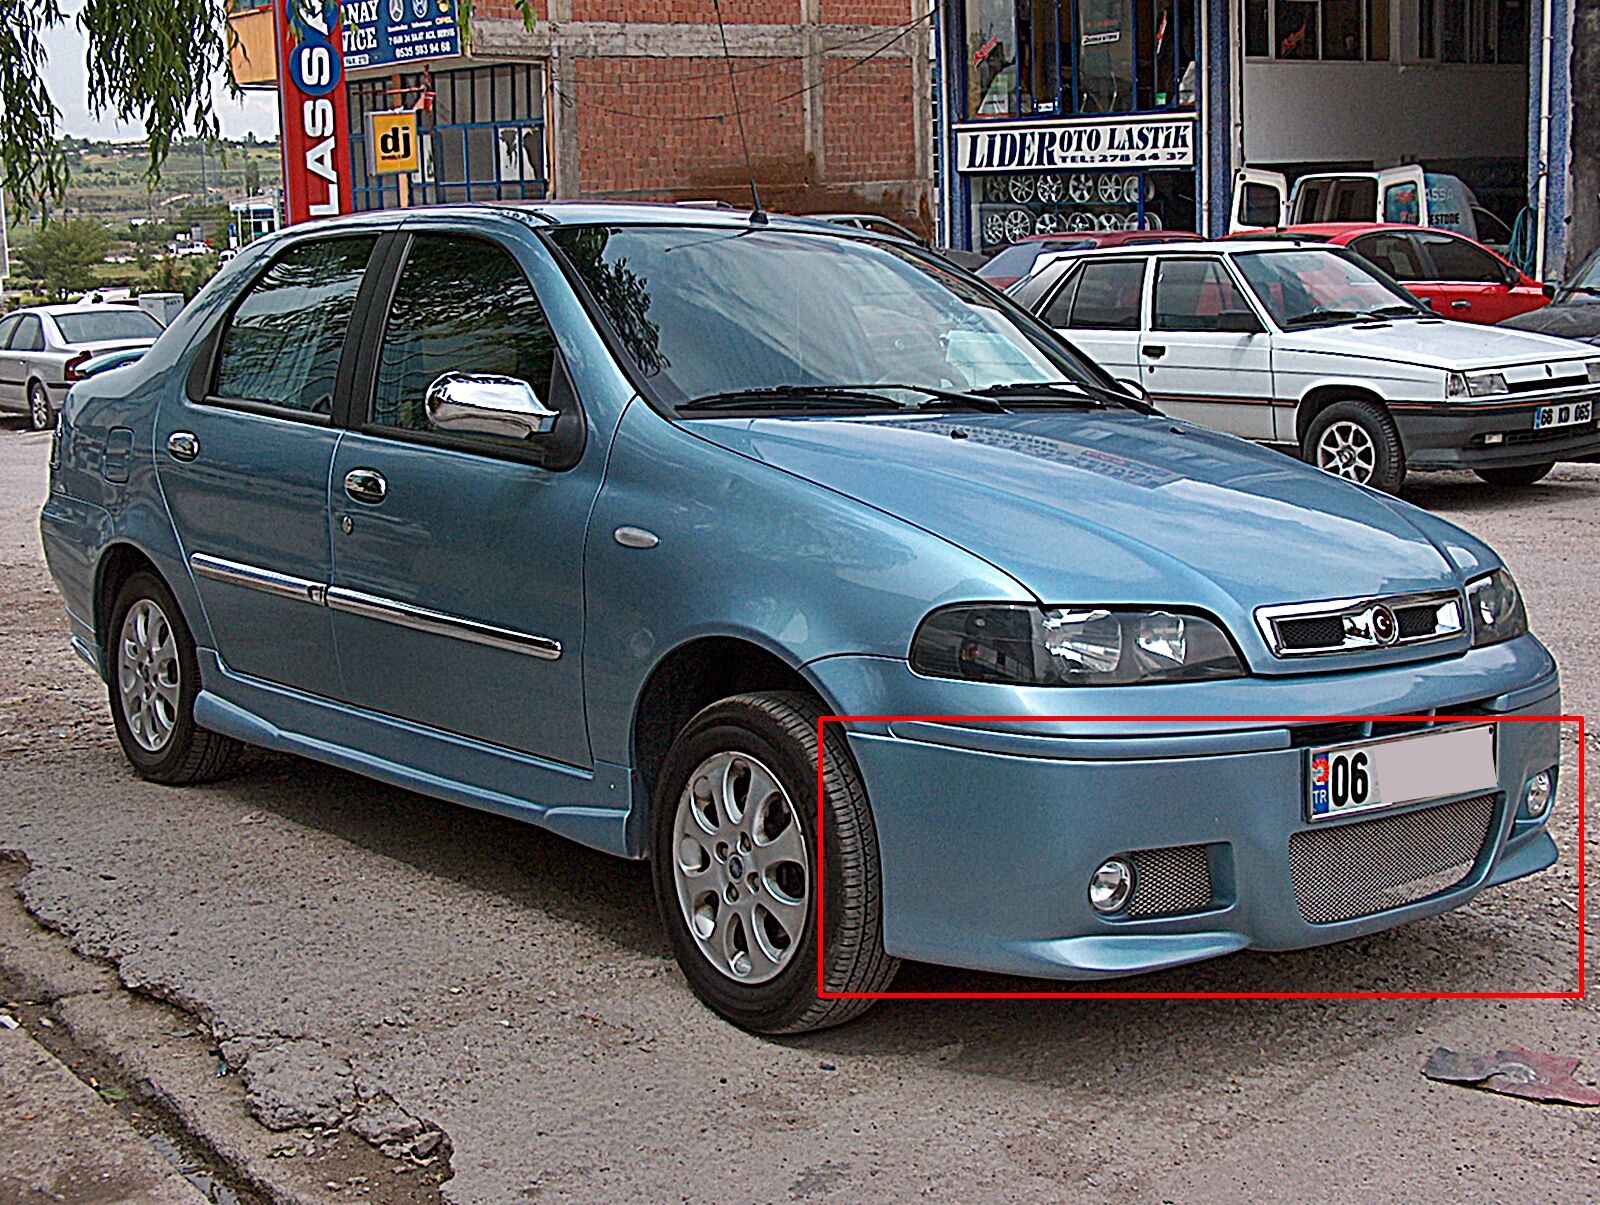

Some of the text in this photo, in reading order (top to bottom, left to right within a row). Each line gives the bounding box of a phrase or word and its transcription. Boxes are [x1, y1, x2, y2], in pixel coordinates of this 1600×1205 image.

[380, 126, 411, 159] dj
[1059, 128, 1101, 153] OTO
[1135, 152, 1160, 161] 44
[1166, 151, 1188, 161] 37
[1331, 751, 1369, 807] 06
[1313, 789, 1328, 804] TR
